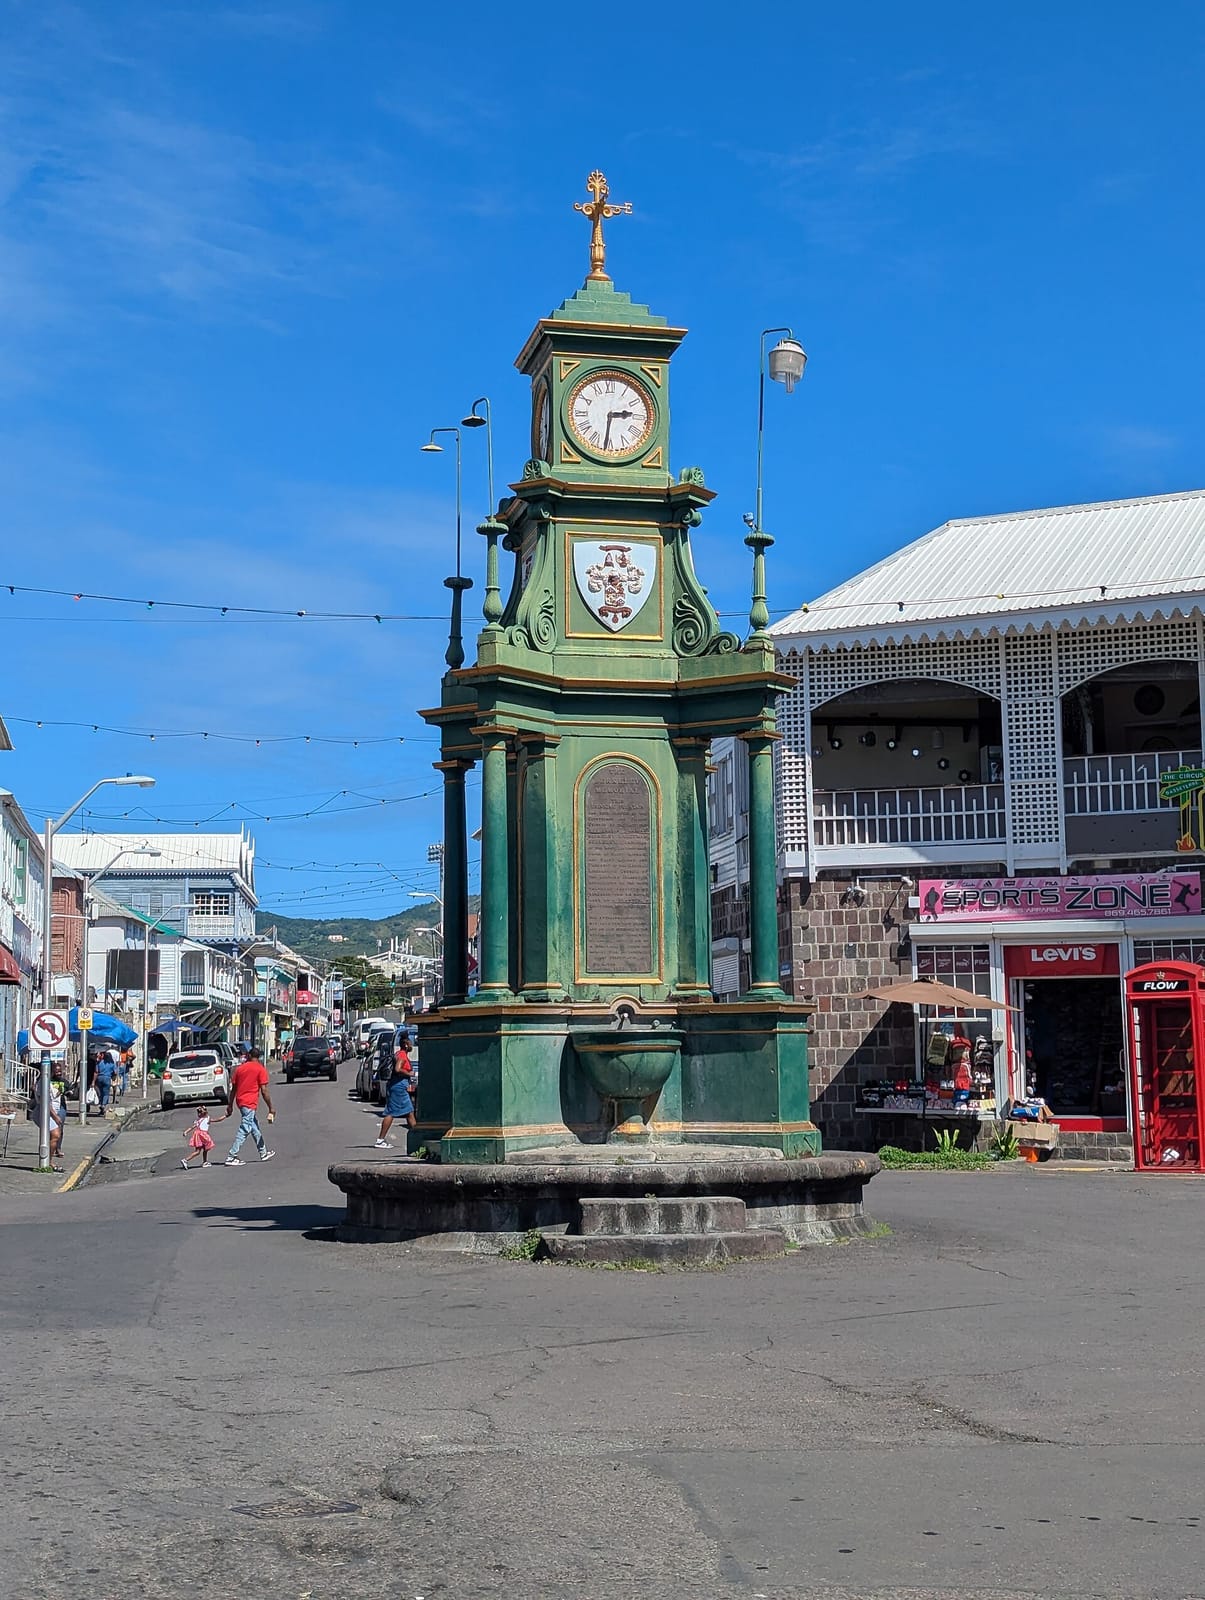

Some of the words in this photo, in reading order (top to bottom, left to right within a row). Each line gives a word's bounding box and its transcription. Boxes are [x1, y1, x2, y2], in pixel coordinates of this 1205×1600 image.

[1179, 772, 1204, 780] CIRCUS
[943, 887, 1060, 907] SPORTS
[1065, 883, 1172, 910] ZONE
[1143, 981, 1179, 991] FLOW
